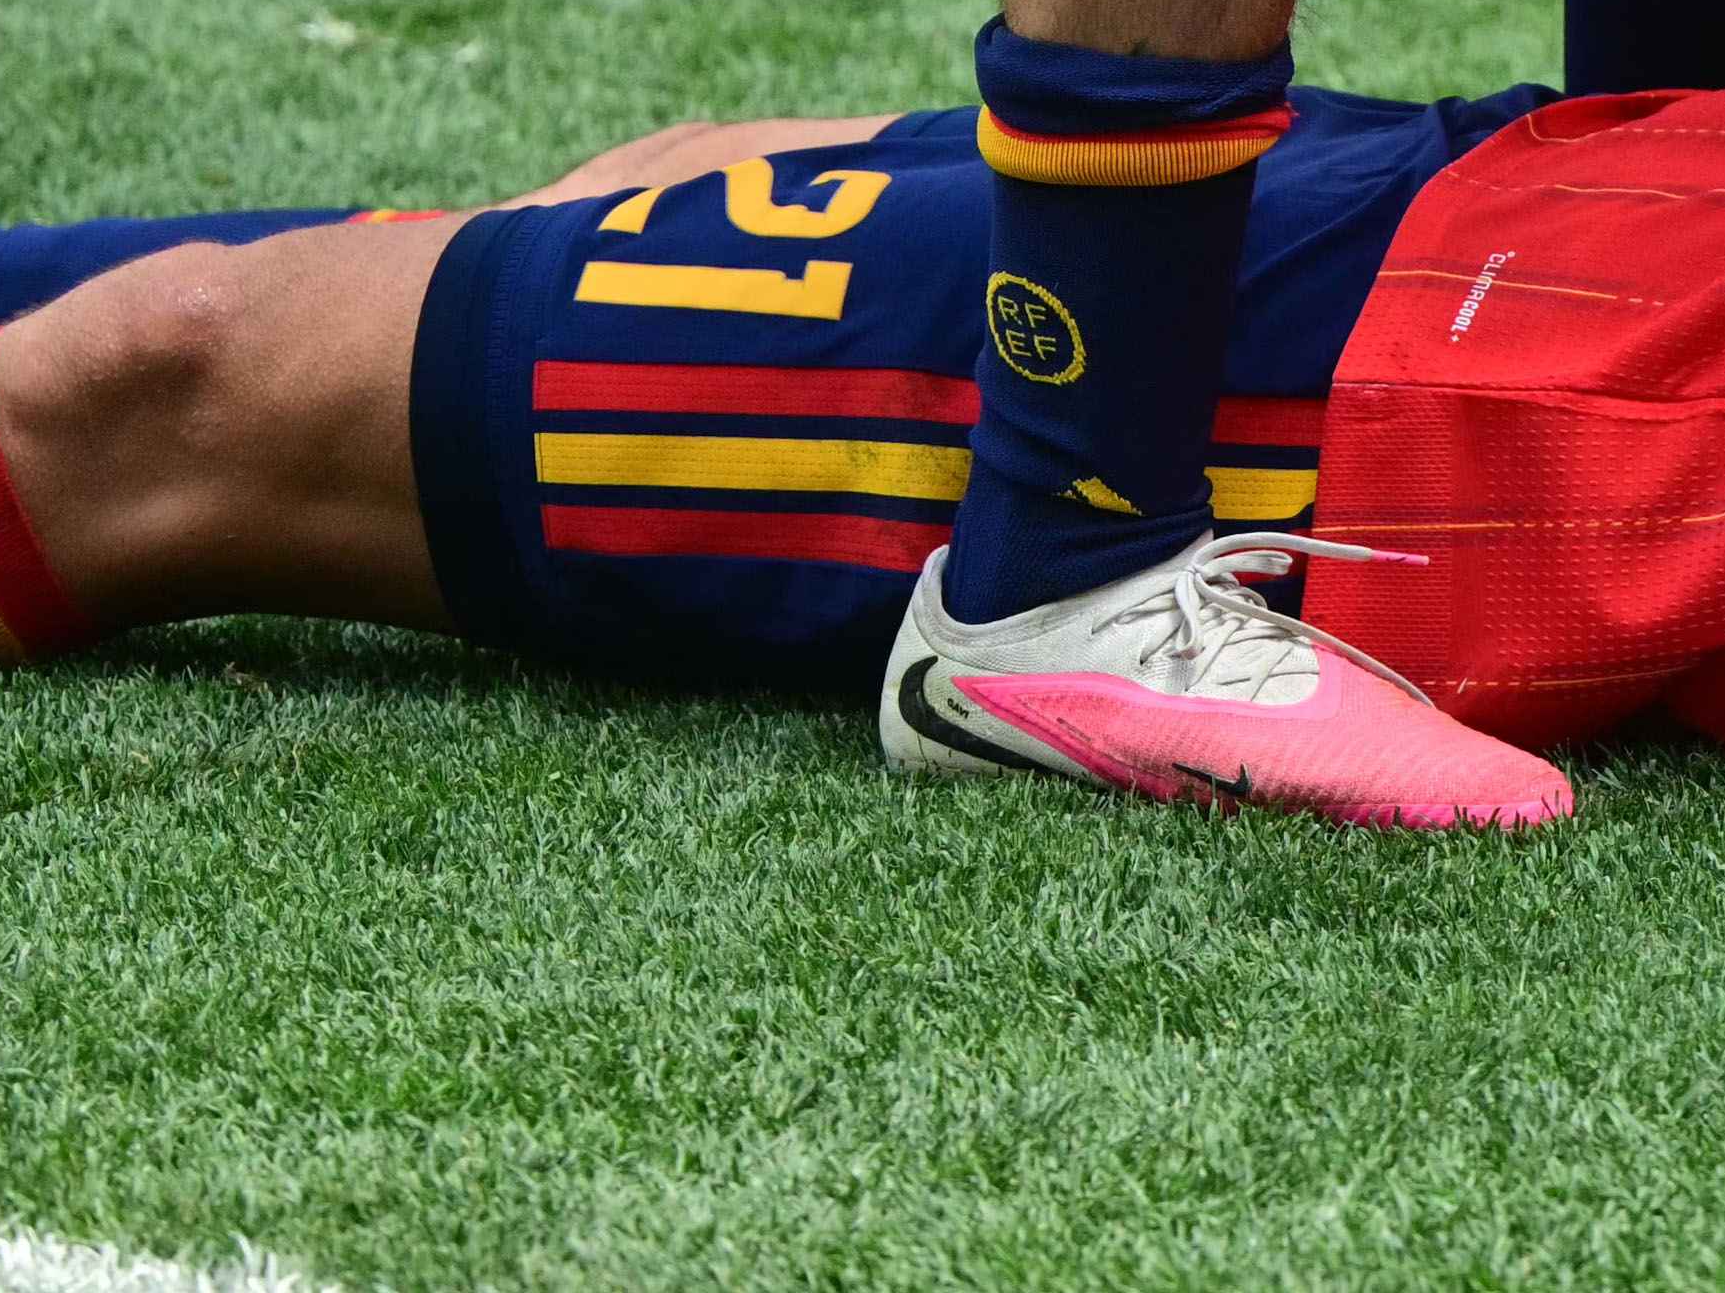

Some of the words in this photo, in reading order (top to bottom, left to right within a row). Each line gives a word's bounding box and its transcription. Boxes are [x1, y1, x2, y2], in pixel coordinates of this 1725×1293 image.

[574, 156, 891, 321] 21
[997, 296, 1047, 328] RF
[1005, 329, 1057, 361] EF
